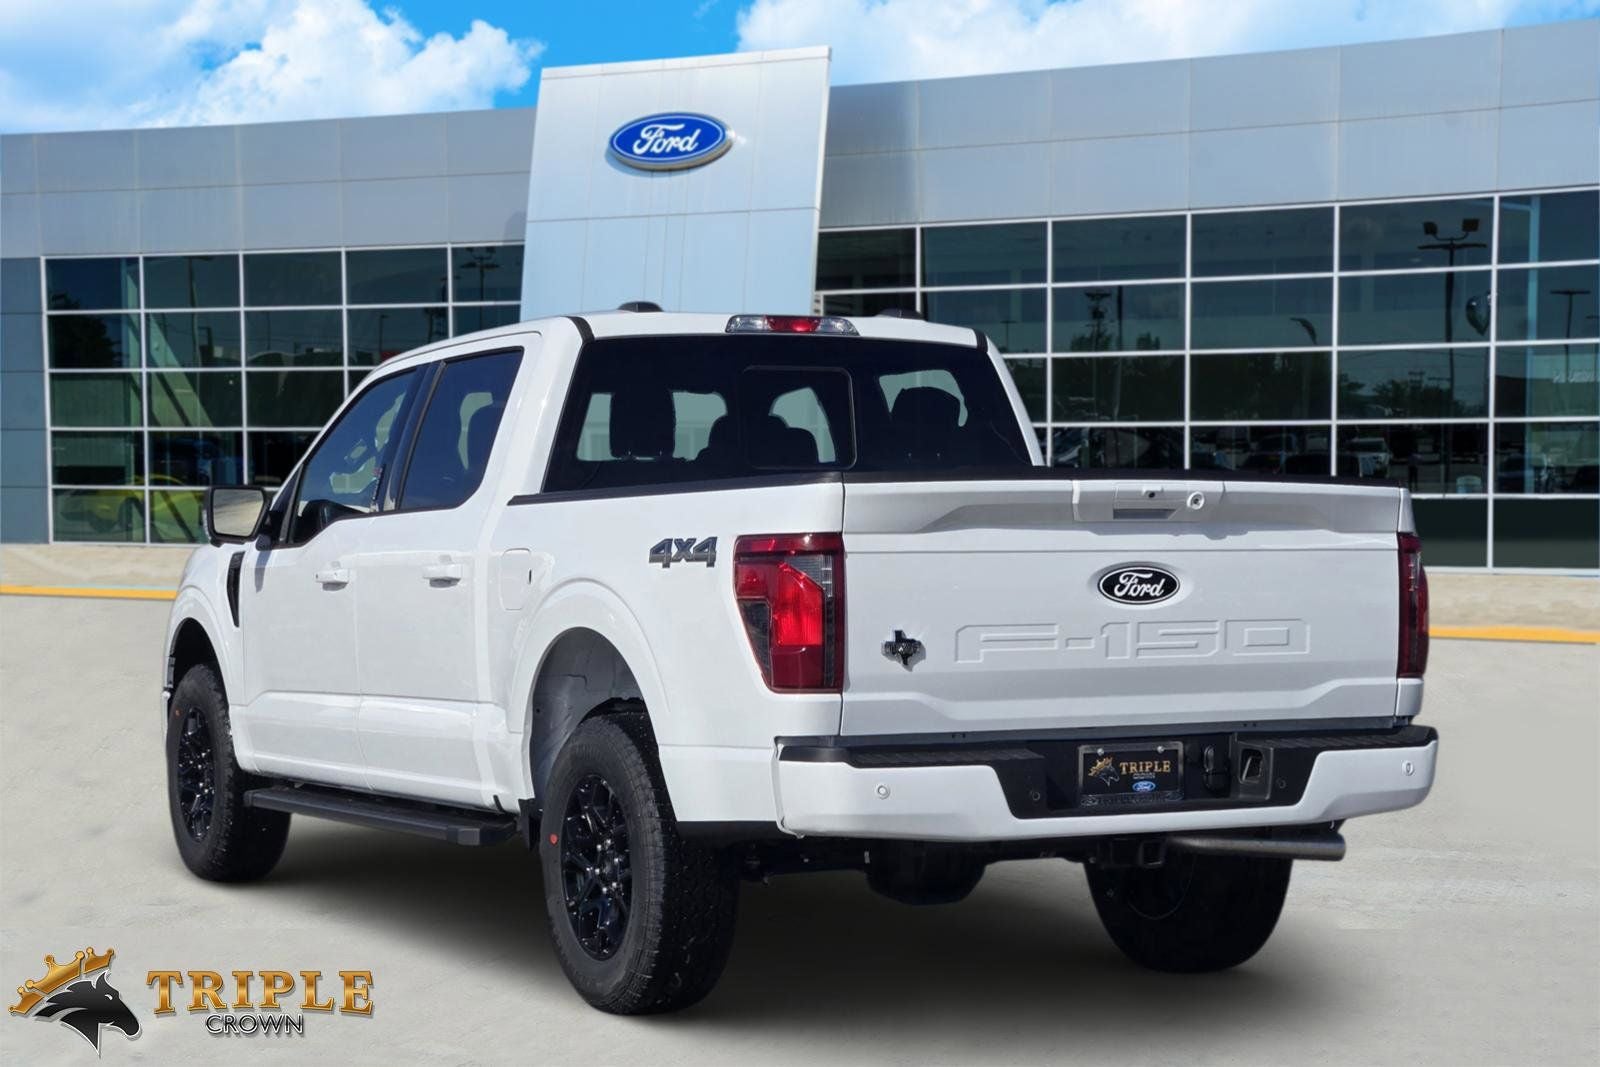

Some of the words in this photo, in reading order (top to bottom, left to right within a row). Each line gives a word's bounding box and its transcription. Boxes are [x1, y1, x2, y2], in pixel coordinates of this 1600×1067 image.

[632, 123, 702, 155] Ford
[1113, 571, 1166, 597] Ford
[954, 618, 1311, 664] F-150
[1119, 760, 1172, 775] TRIPLE
